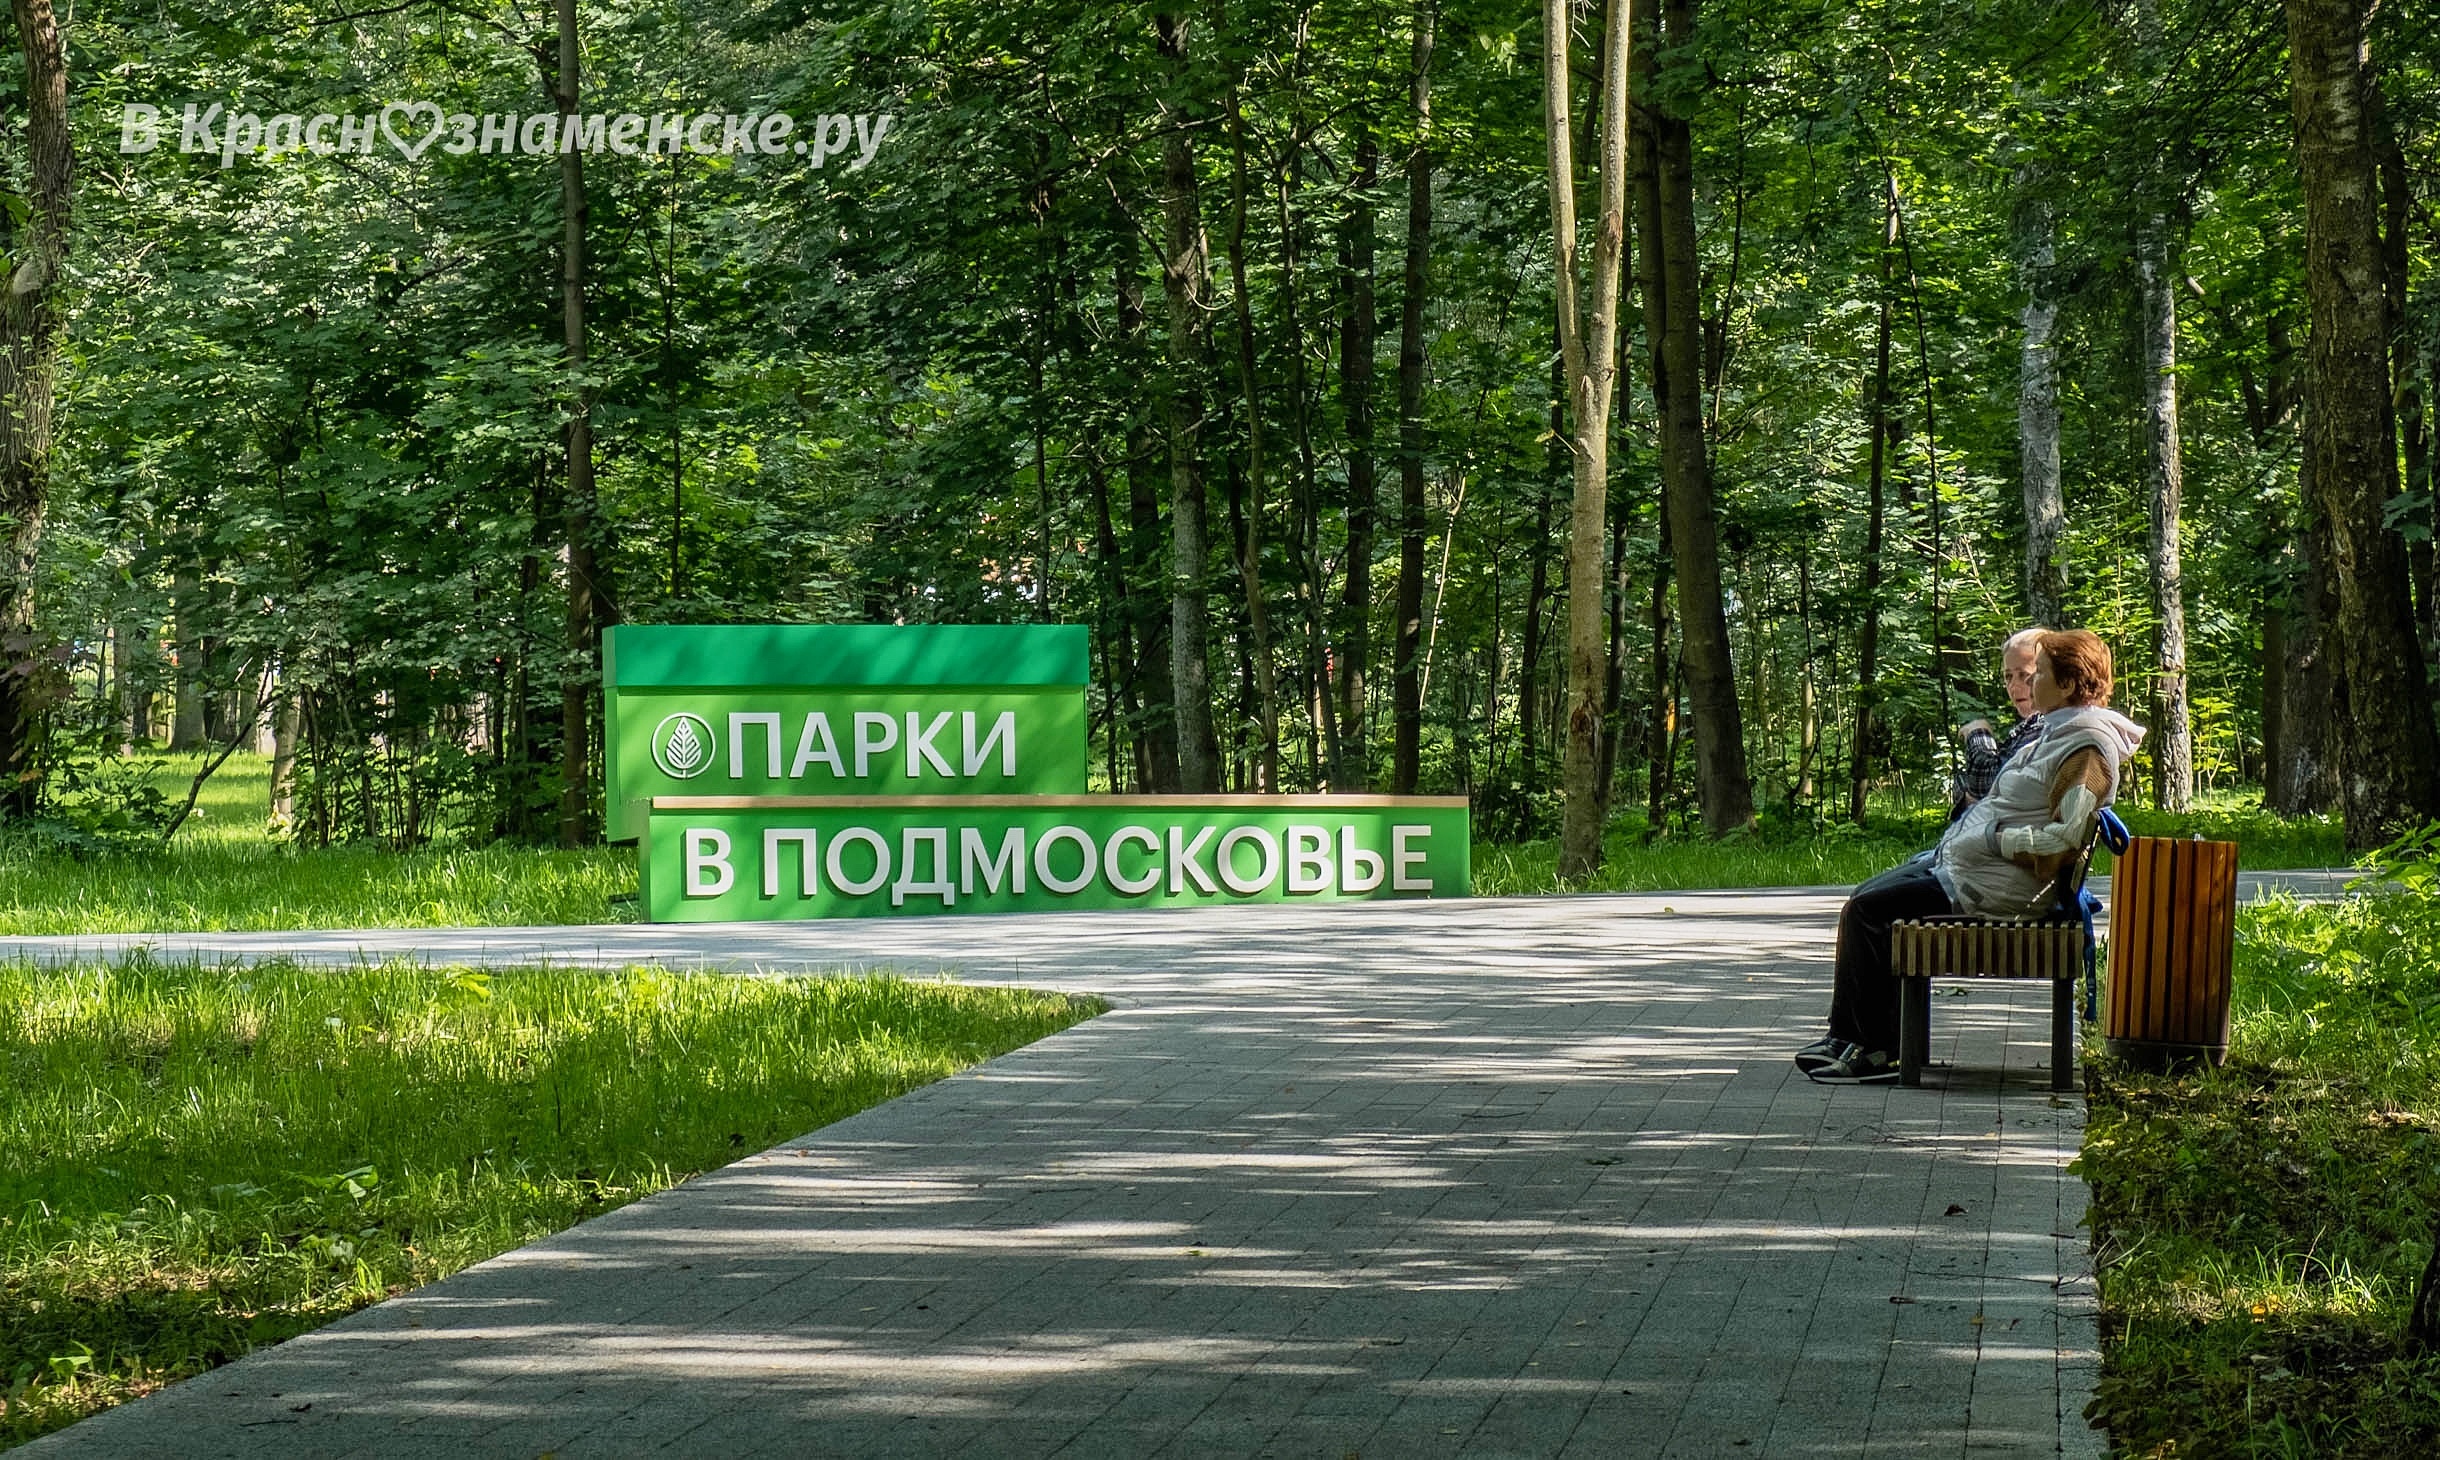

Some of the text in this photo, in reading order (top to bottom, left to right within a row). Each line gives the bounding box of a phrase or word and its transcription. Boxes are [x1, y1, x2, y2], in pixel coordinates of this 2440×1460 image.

[728, 711, 1017, 778] ПАРКИ
[684, 825, 1433, 906] В ПОДМОСКОВЬЕ
